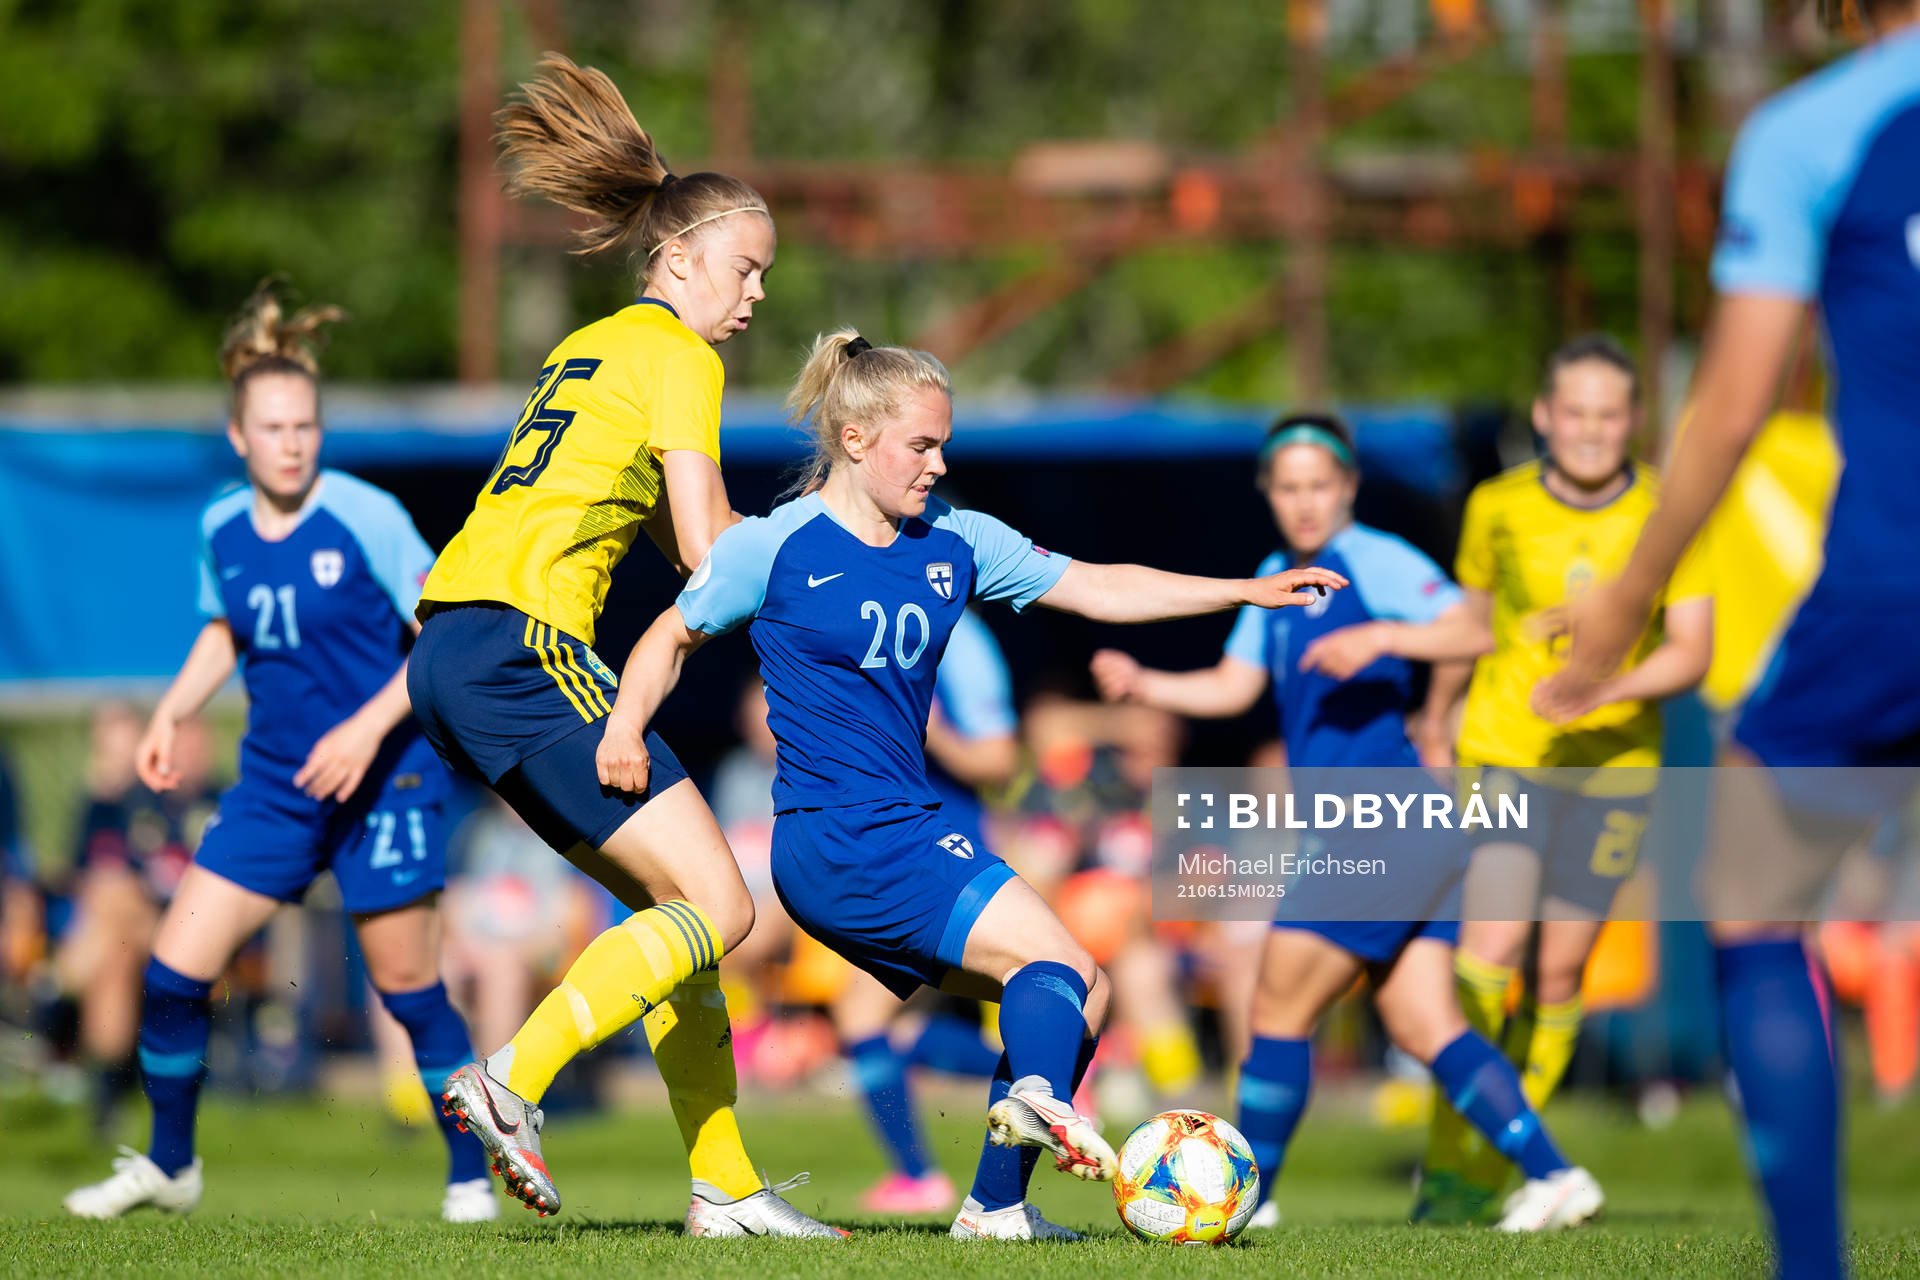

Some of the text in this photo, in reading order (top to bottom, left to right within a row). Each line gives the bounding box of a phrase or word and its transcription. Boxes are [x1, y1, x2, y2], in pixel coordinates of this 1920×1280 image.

[247, 583, 301, 650] 21
[860, 600, 930, 669] 20
[365, 808, 427, 870] 21
